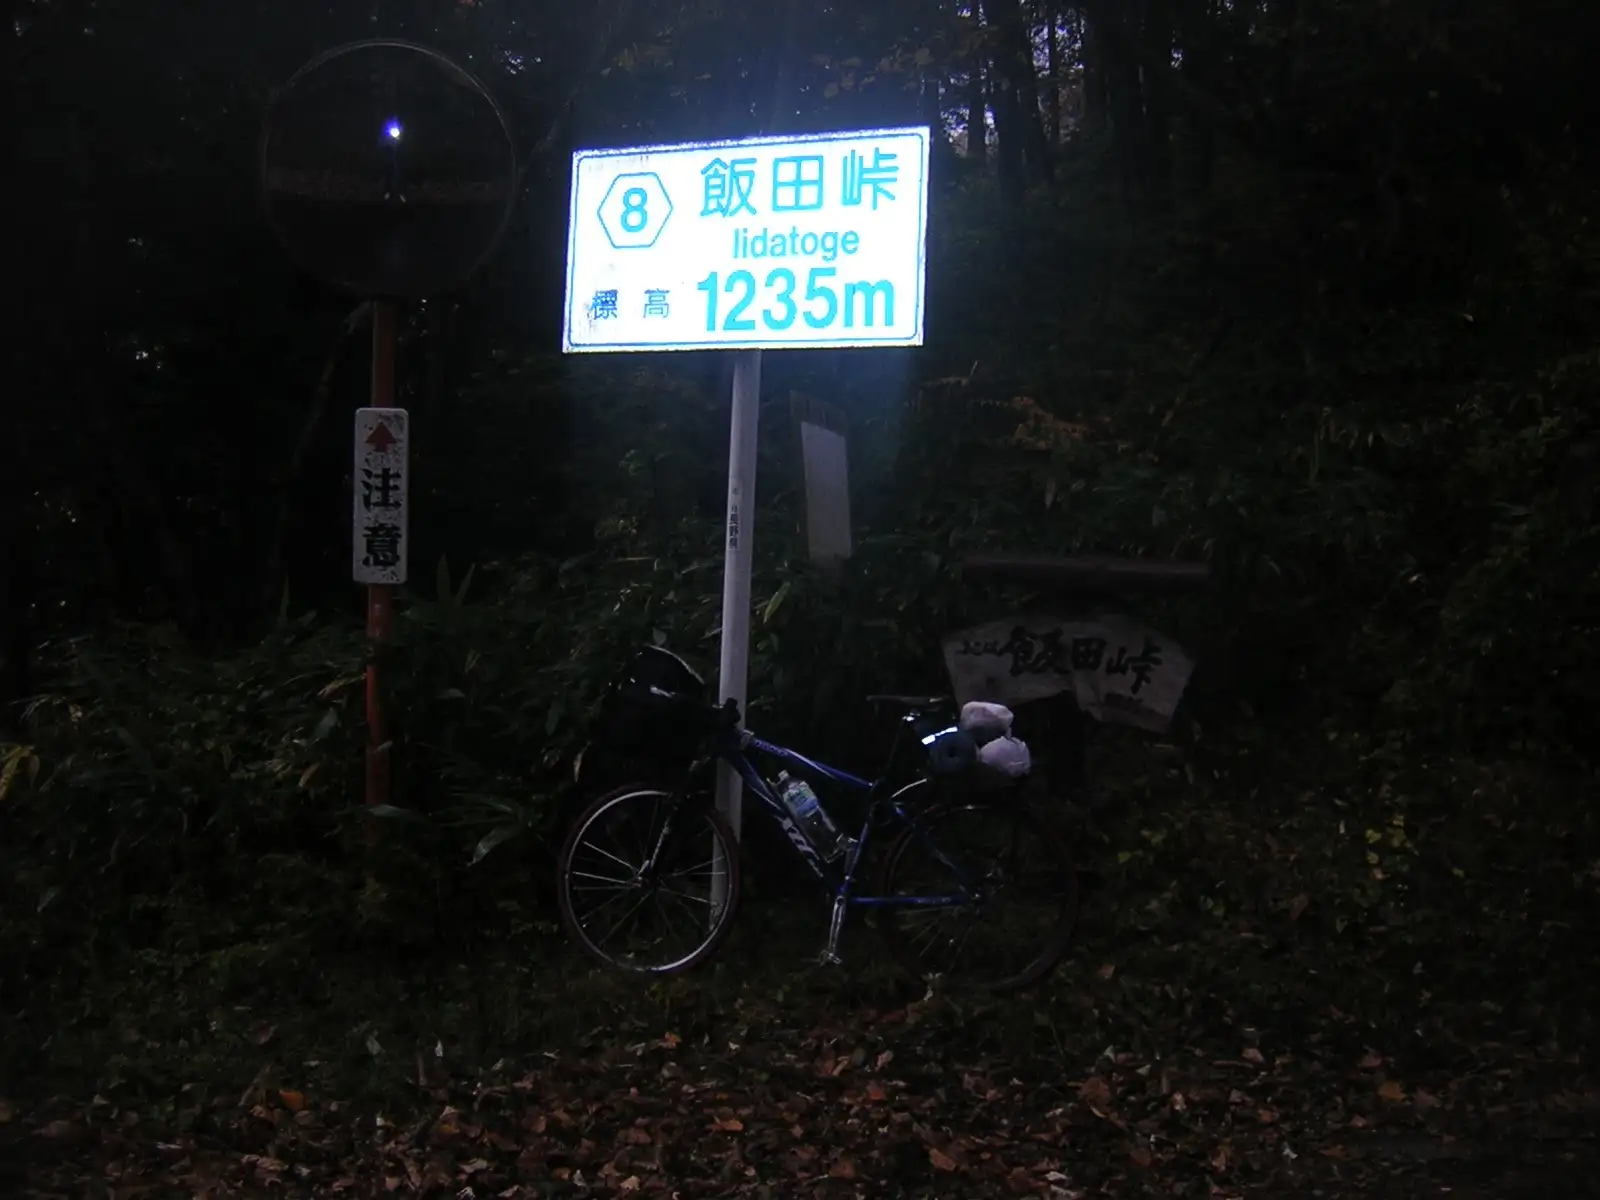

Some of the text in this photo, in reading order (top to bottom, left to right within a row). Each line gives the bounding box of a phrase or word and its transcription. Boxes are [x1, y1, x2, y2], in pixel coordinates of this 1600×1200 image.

[620, 186, 648, 233] 8
[700, 147, 899, 218] 飯田峠
[590, 287, 671, 320] 標高
[697, 266, 895, 331] 1235m
[361, 467, 402, 566] 注意
[1006, 625, 1162, 695] 飯田峠
